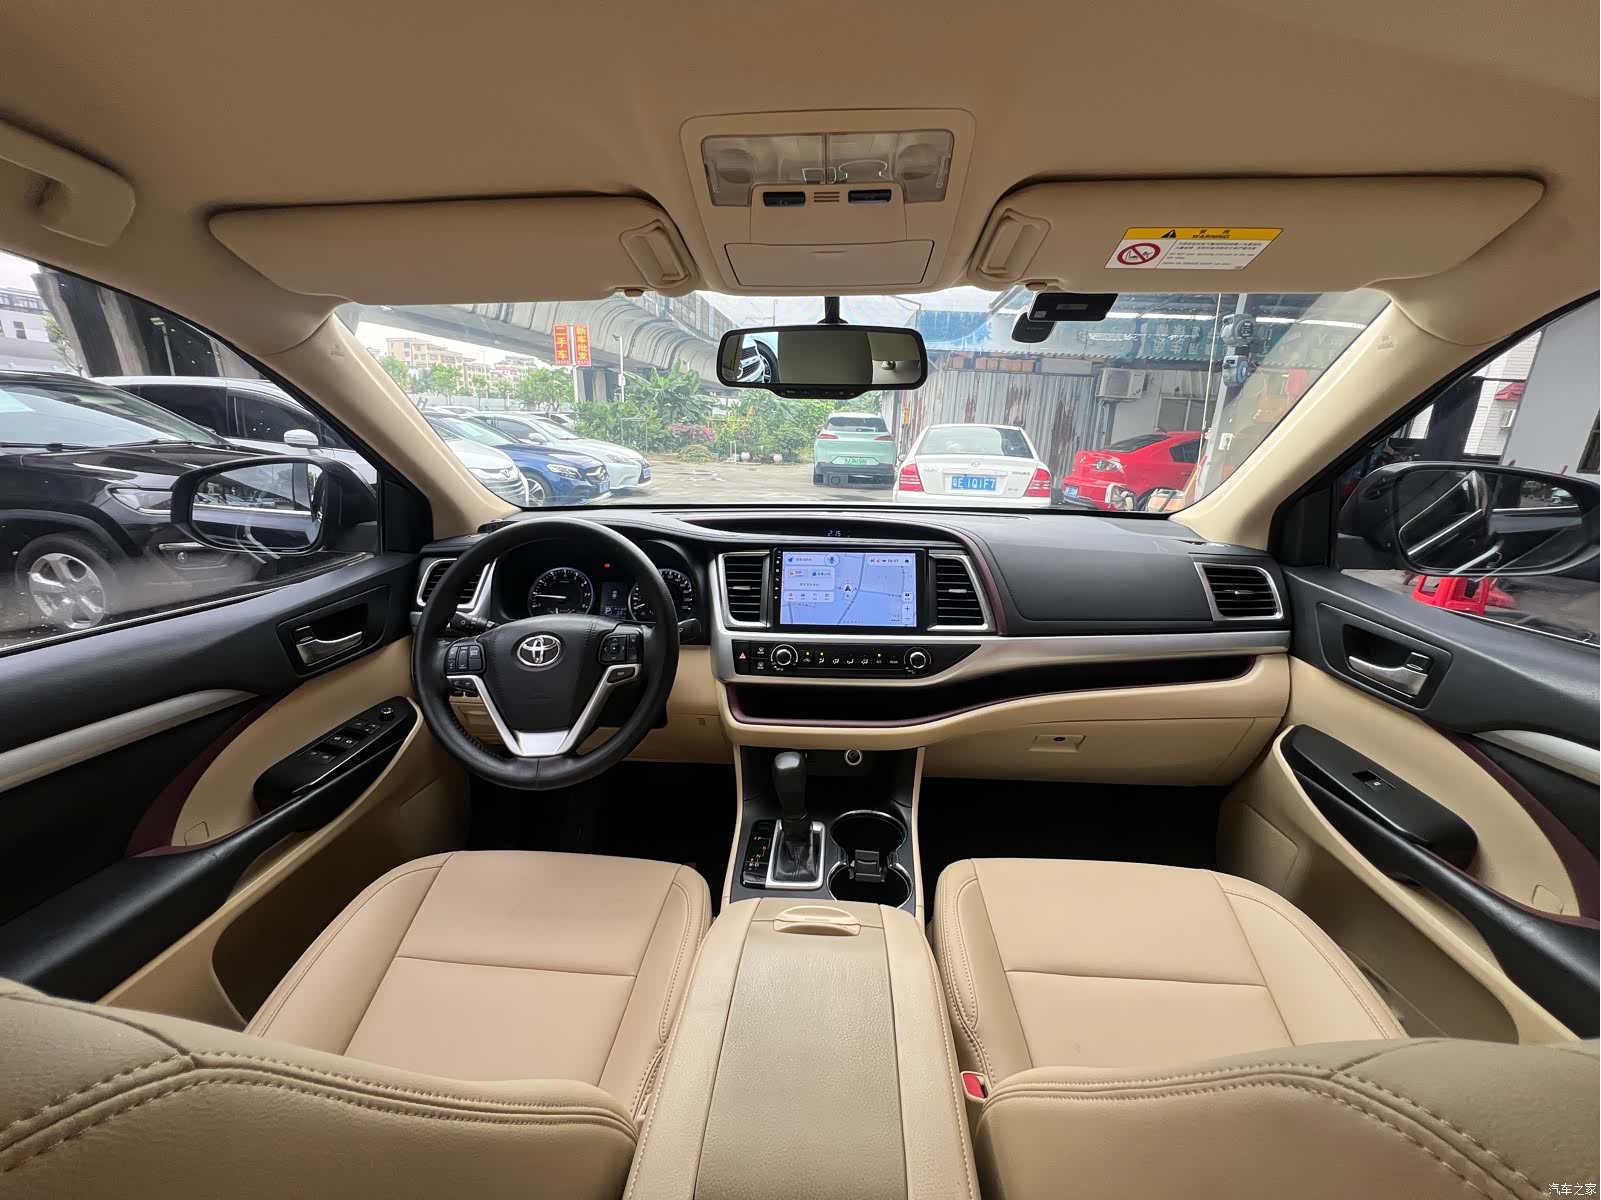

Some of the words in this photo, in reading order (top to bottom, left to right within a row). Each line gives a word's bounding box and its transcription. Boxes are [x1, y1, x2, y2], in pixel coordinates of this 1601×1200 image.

[555, 326, 568, 360] 二手车
[575, 325, 588, 360] 新车批发
